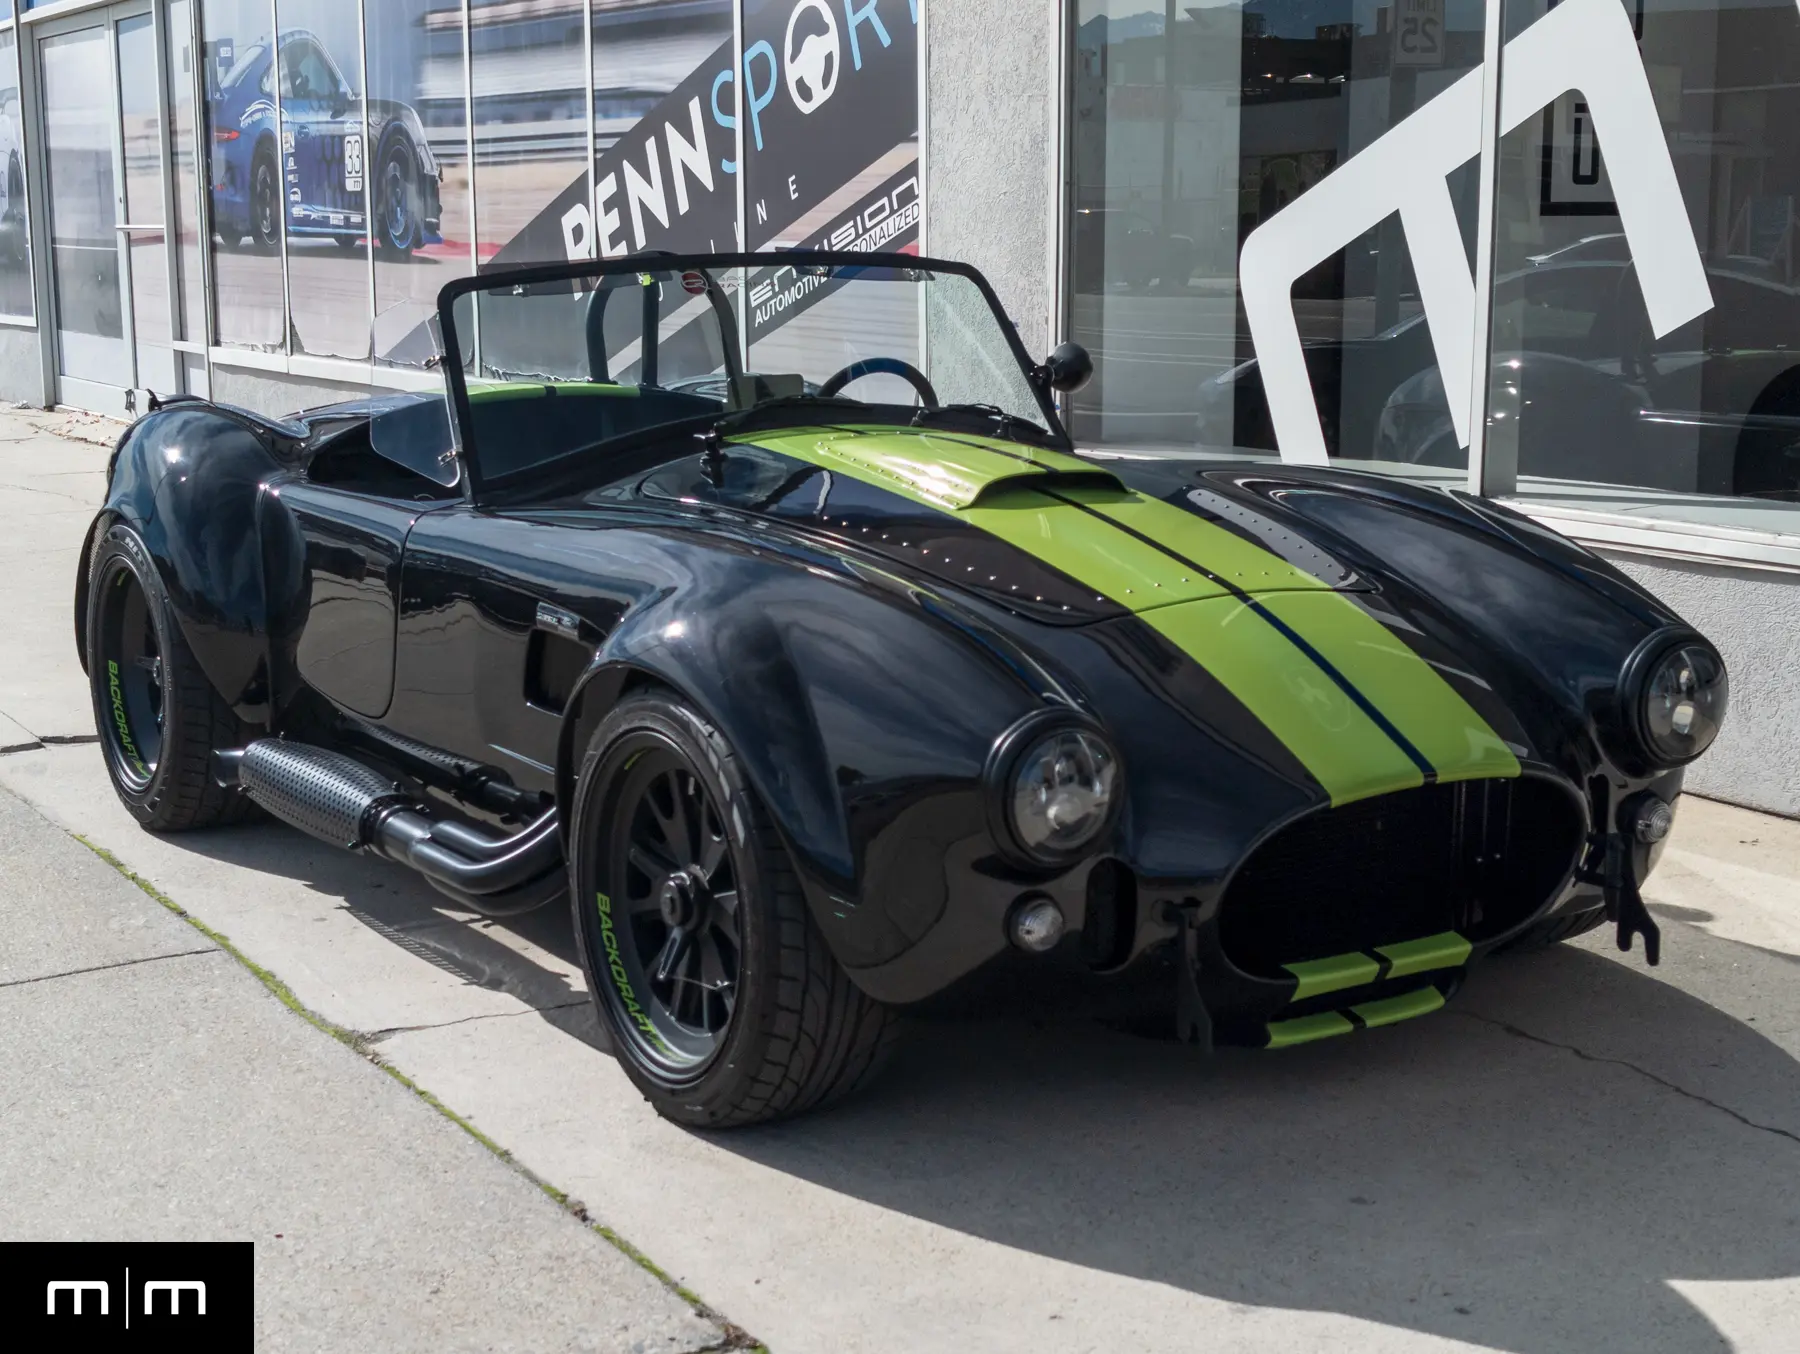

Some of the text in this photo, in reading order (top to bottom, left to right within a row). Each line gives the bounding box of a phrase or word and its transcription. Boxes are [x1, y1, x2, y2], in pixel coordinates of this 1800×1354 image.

[346, 140, 360, 175] 33
[108, 659, 139, 762] BACKDRAFT
[596, 891, 657, 1035] BACKDRAFT
